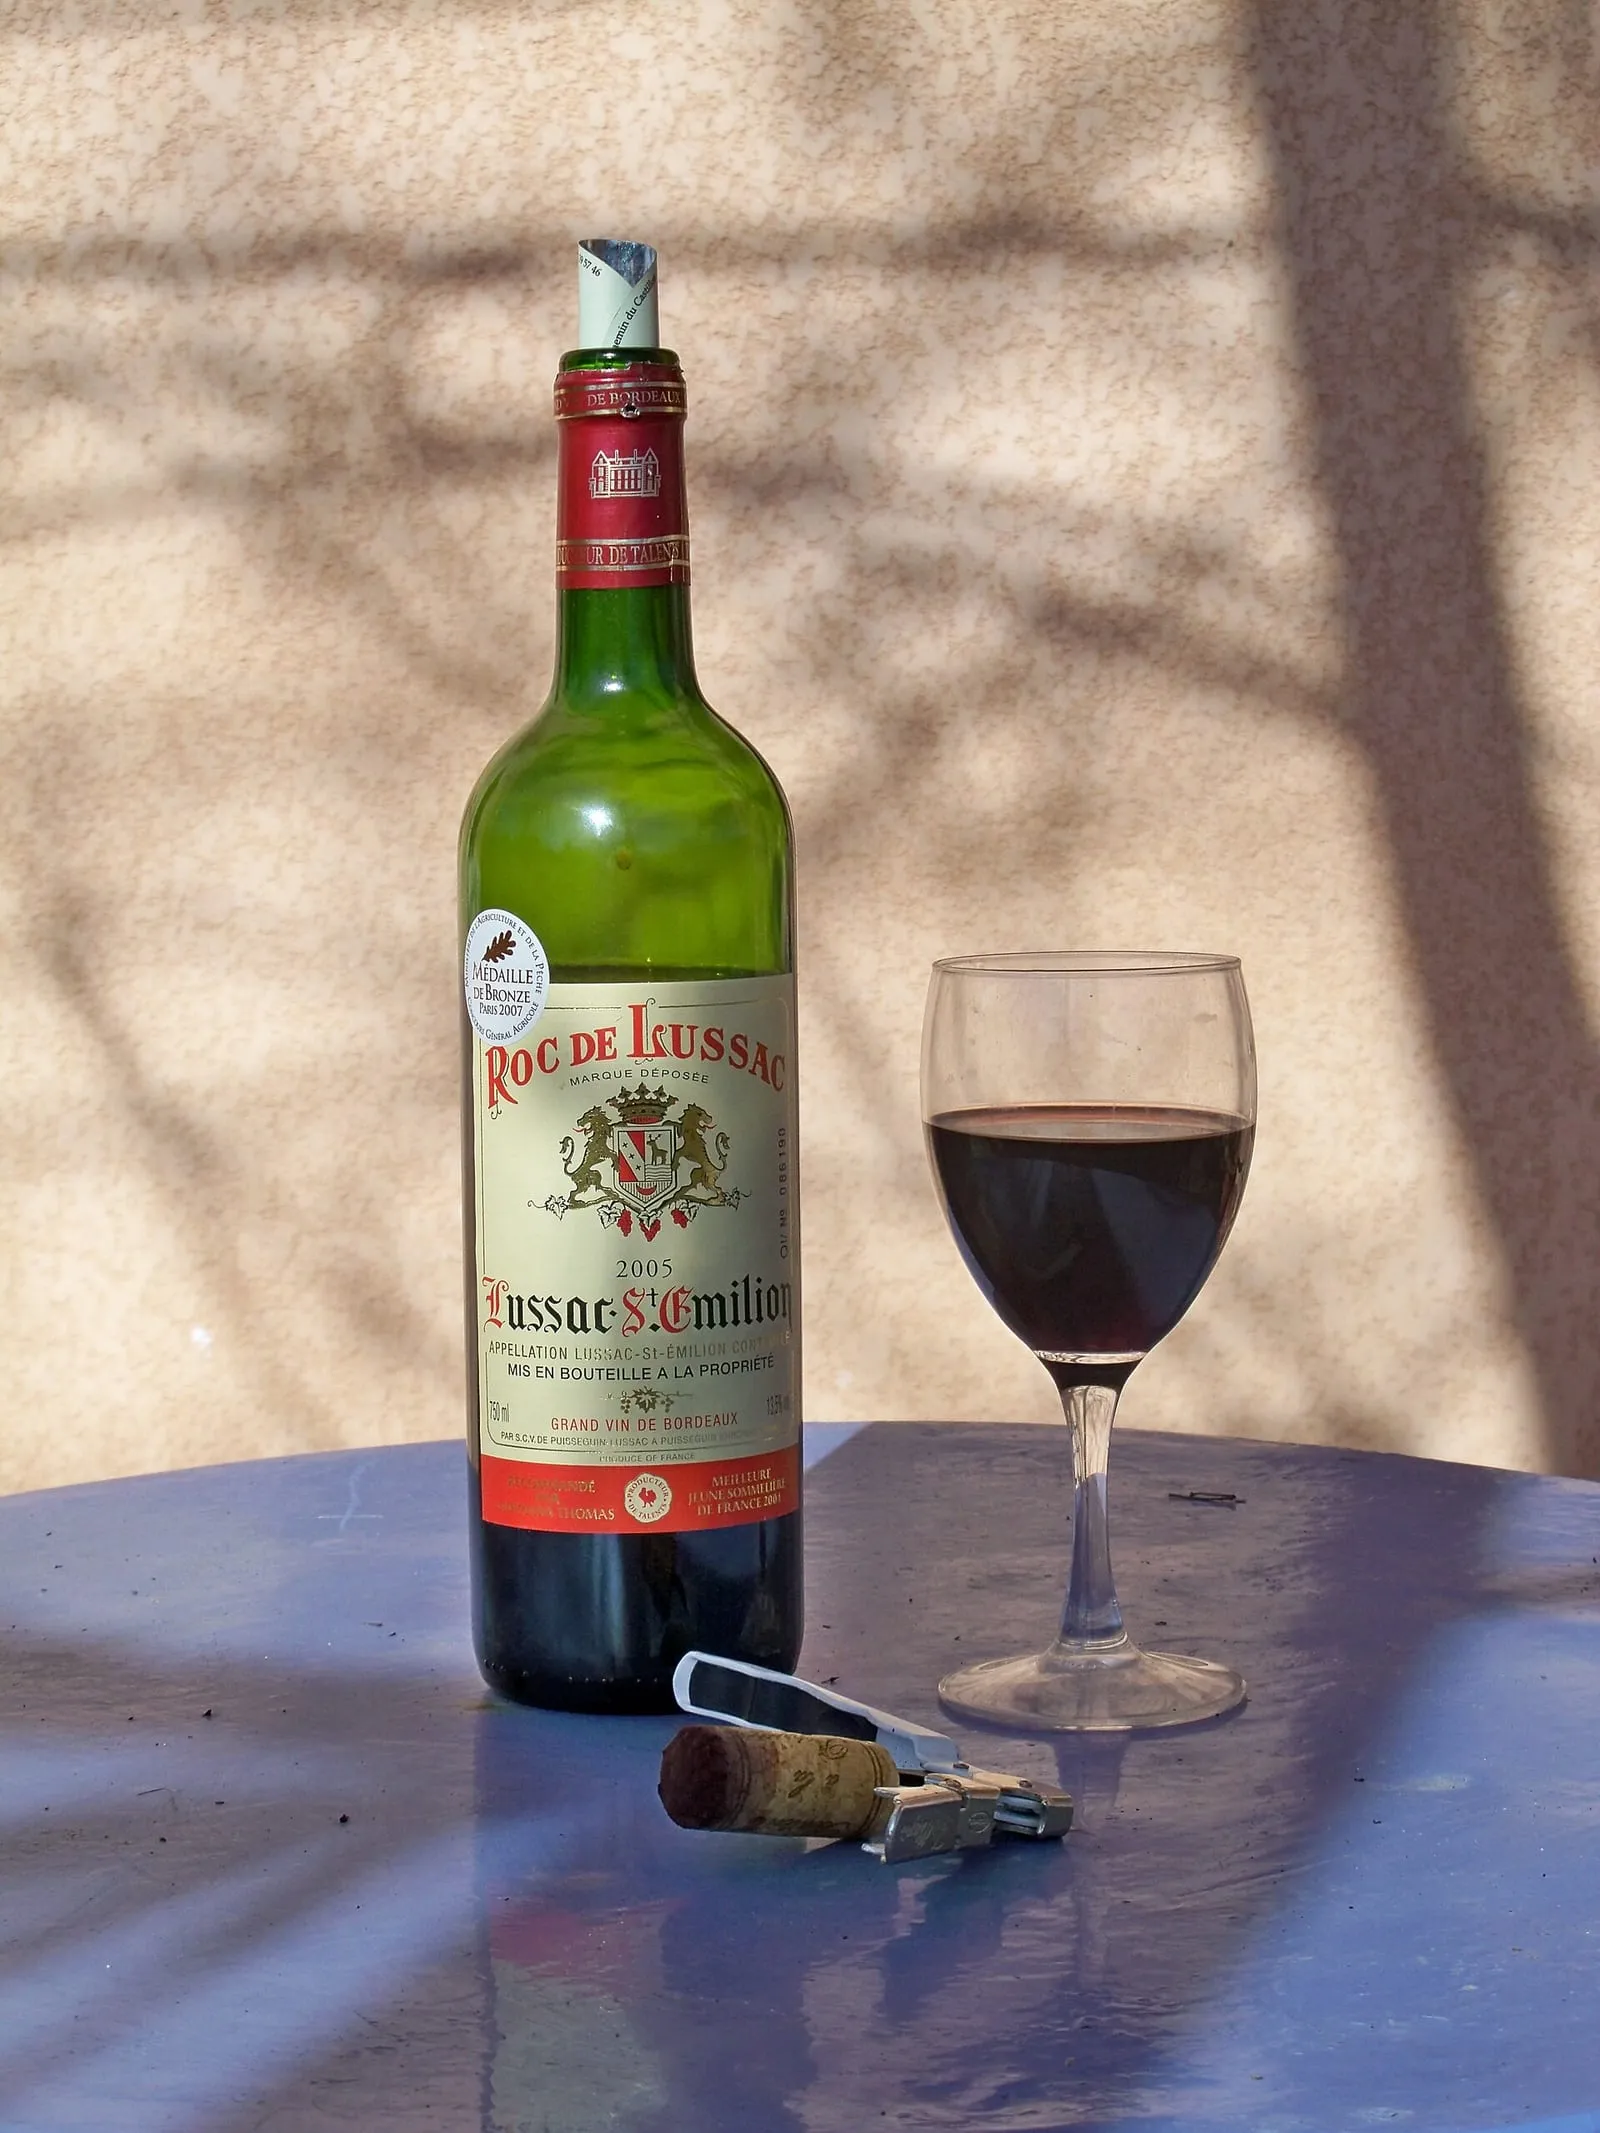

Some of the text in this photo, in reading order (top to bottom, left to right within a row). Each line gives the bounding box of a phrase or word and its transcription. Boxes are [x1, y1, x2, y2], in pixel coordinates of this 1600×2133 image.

[583, 258, 592, 268] 57
[592, 266, 603, 277] 46
[625, 307, 637, 320] du
[587, 390, 680, 406] DE BORDEAUX
[609, 546, 628, 565] DE
[517, 927, 527, 937] ET
[525, 937, 536, 949] DE
[531, 949, 540, 961] LA
[472, 961, 533, 985] MÉDAILLE
[473, 983, 531, 1003] DE BRONZE
[479, 1002, 523, 1017] PARIS 2007
[512, 1002, 539, 1036] AGRICOLE
[485, 998, 786, 1112] ROC DE LUSSAC
[569, 1068, 710, 1087] MARQUE DÉPOSÉE
[778, 1127, 787, 1196] 086190
[616, 1258, 673, 1279] 2005
[659, 1273, 793, 1333] Emilion
[489, 1340, 568, 1360] APPELLATION
[508, 1352, 775, 1381] MIS EN BOUTEILLE A LA PROPRIÉTÉ
[489, 1400, 501, 1421] 750
[501, 1403, 510, 1423] ml
[551, 1412, 739, 1432] GRAND VIN DE BORDEAUX
[501, 1431, 514, 1441] PAR
[651, 1438, 659, 1446] A
[645, 1454, 657, 1463] OF
[661, 1453, 695, 1462] FRANCE
[627, 1476, 669, 1498] PRODUCTEUR
[712, 1467, 771, 1488] MEILLEURE
[688, 1490, 725, 1506] JEUNE
[697, 1503, 713, 1516] DE
[717, 1496, 762, 1514] FRANCE
[558, 1507, 616, 1521] THOMAS
